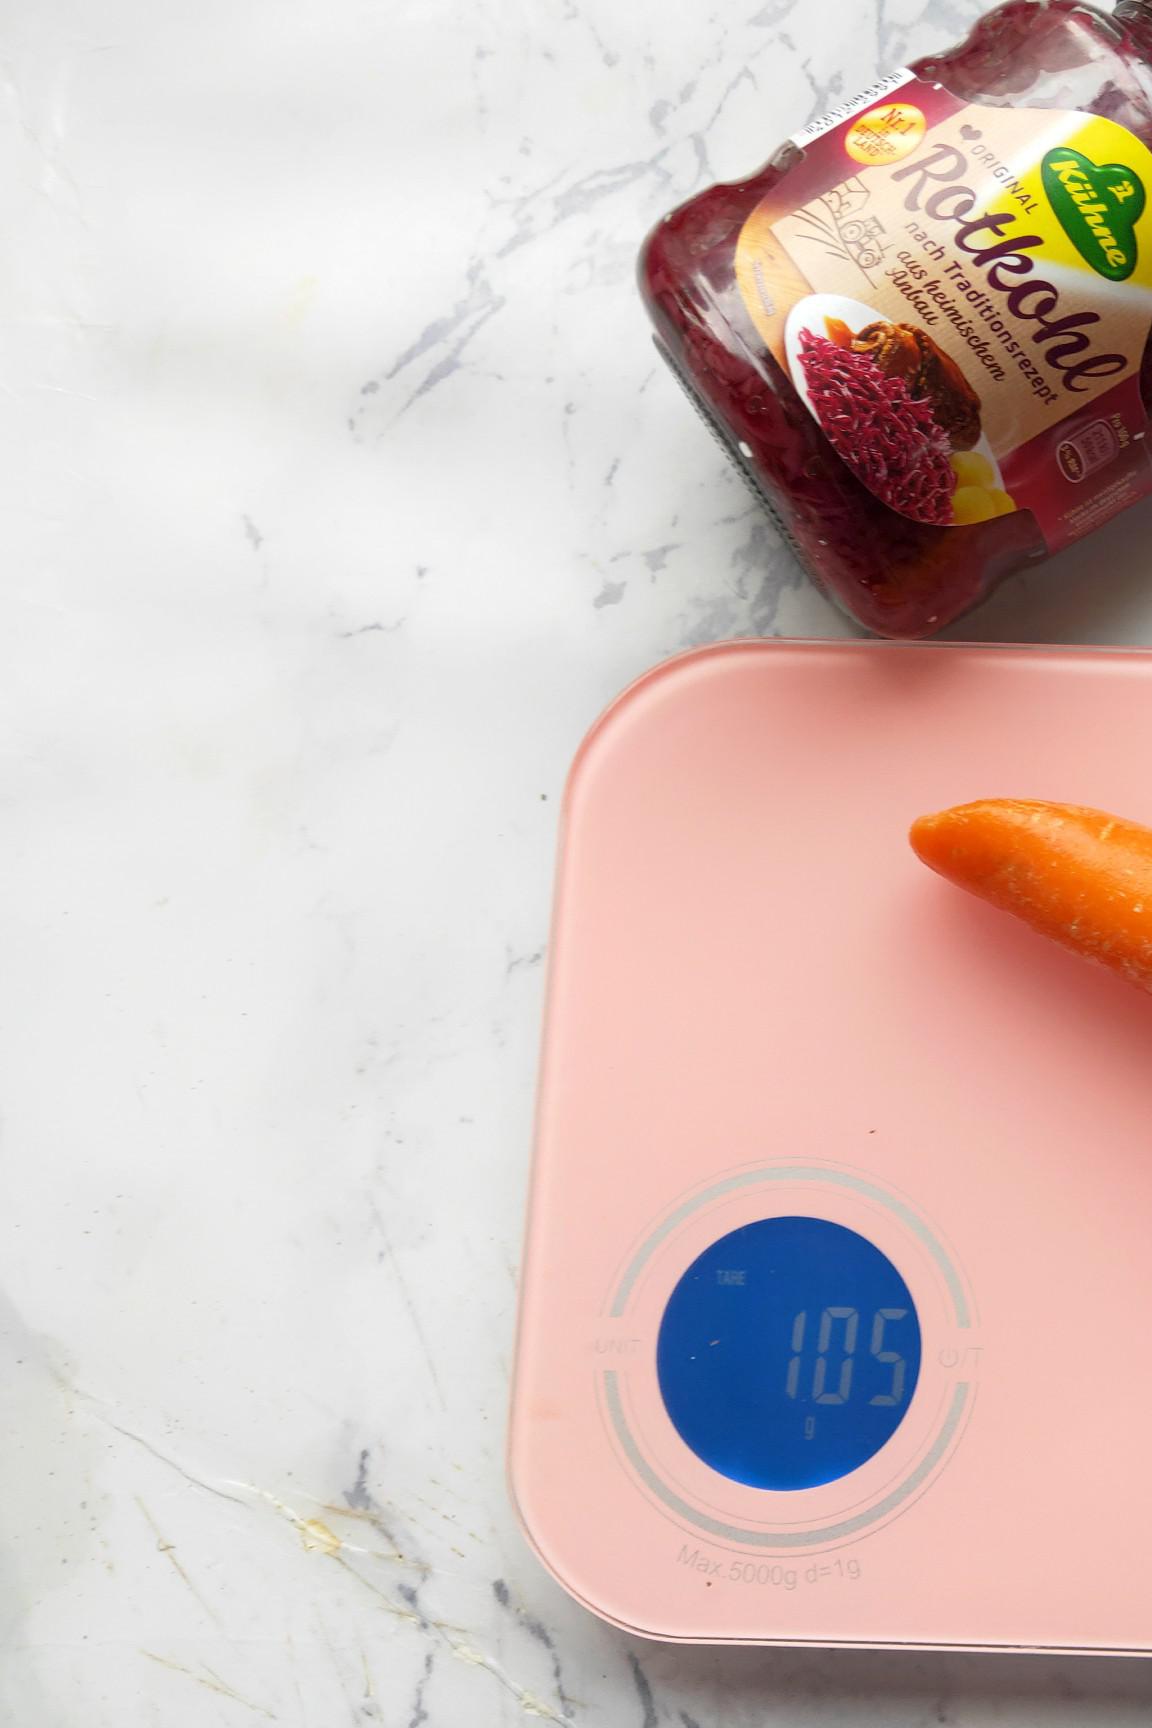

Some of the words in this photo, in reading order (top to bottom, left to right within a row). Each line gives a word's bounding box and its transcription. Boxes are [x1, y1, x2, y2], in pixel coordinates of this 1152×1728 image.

[970, 144, 1040, 216] ORIGINAL
[1049, 160, 1128, 268] Kühne
[885, 267, 938, 326] Anbau
[890, 142, 1128, 392] Rotkohl
[896, 250, 929, 280] aus
[922, 279, 1006, 382] heimischem
[904, 221, 946, 262] nach
[943, 260, 1060, 405] Traditionsrezept
[786, 1306, 909, 1407] 105
[804, 1415, 816, 1441] g
